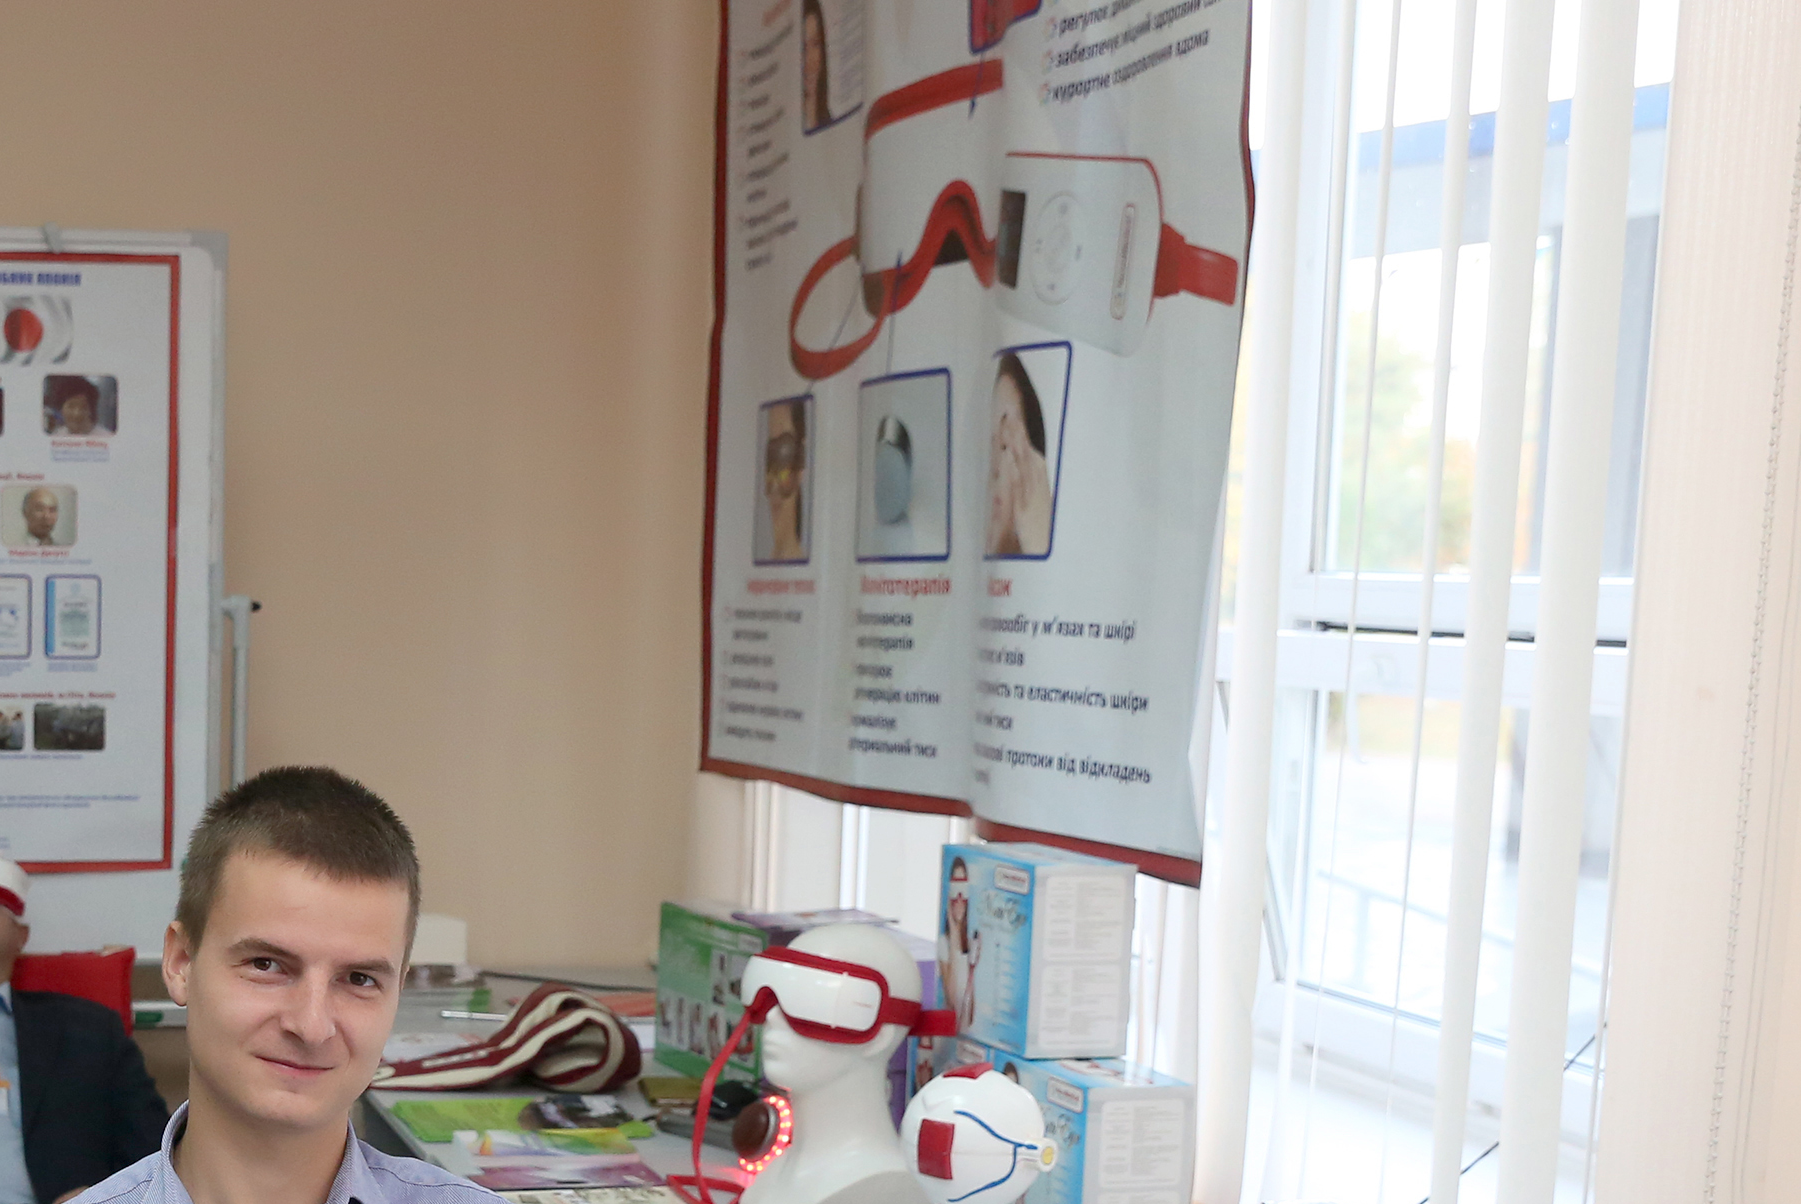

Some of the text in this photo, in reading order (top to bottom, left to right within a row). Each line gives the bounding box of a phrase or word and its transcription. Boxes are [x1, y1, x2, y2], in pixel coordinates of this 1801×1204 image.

[1088, 623, 1101, 639] та
[1104, 619, 1138, 644] шкірі
[1014, 683, 1025, 698] та
[1027, 686, 1106, 708] еластичність
[1110, 692, 1148, 715] шкіри
[1078, 755, 1152, 784] відкладень
